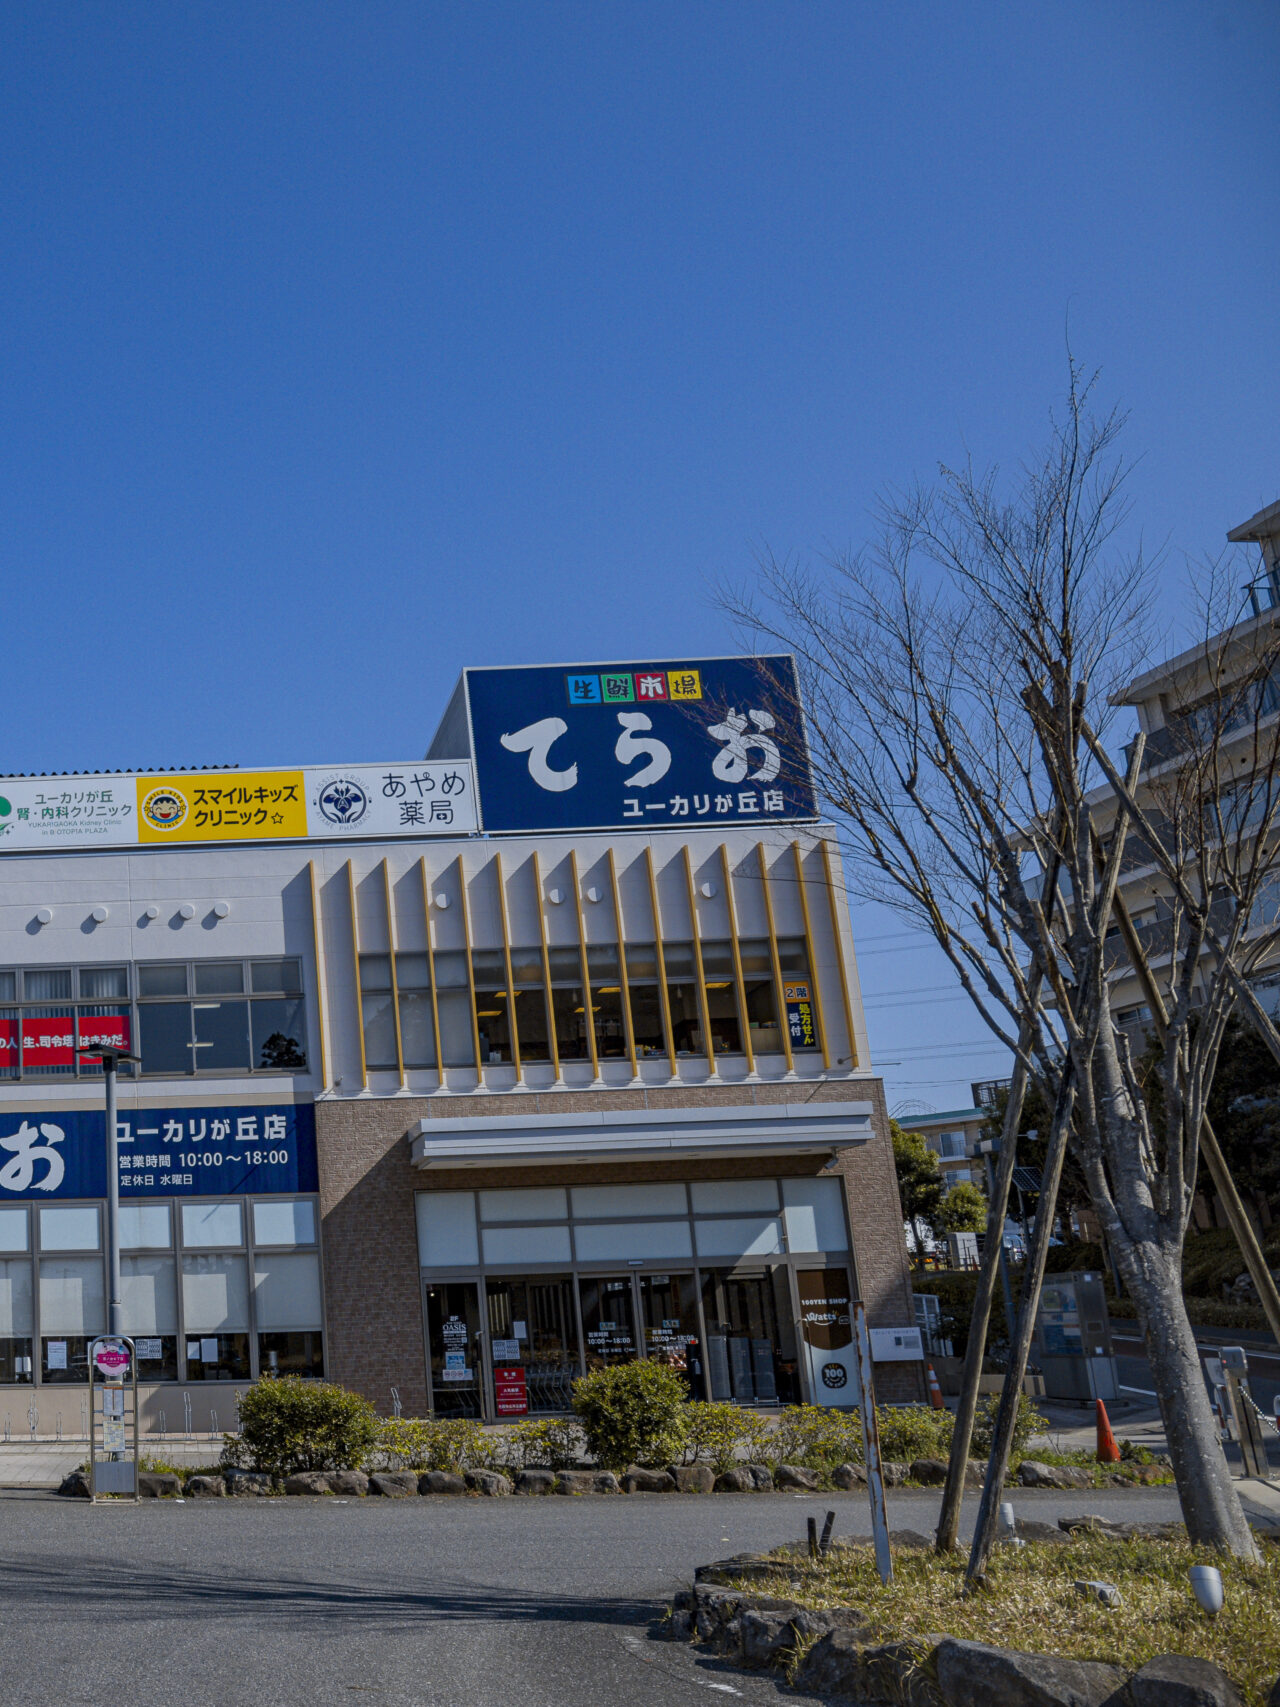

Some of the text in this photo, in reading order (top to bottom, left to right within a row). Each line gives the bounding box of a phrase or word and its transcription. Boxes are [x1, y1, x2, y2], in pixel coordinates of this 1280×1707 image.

[574, 674, 697, 699] 生鮮市場
[500, 707, 781, 793] てらお
[193, 784, 299, 806] スマイルキッズ
[382, 771, 466, 798] あやめ
[34, 790, 113, 805] ユーカリが丘
[623, 789, 785, 817] ユーカリが丘店
[17, 804, 132, 820] 腎・内科クリニック
[194, 808, 268, 828] クリニック
[399, 800, 454, 825] 薬局
[28, 820, 78, 828] YUKARIGAOKA
[116, 1114, 287, 1143] ユーカリが丘店
[119, 1154, 171, 1169] 営業時間
[121, 1173, 193, 1187] 定休日 水曜日
[825, 1368, 844, 1378] 100
